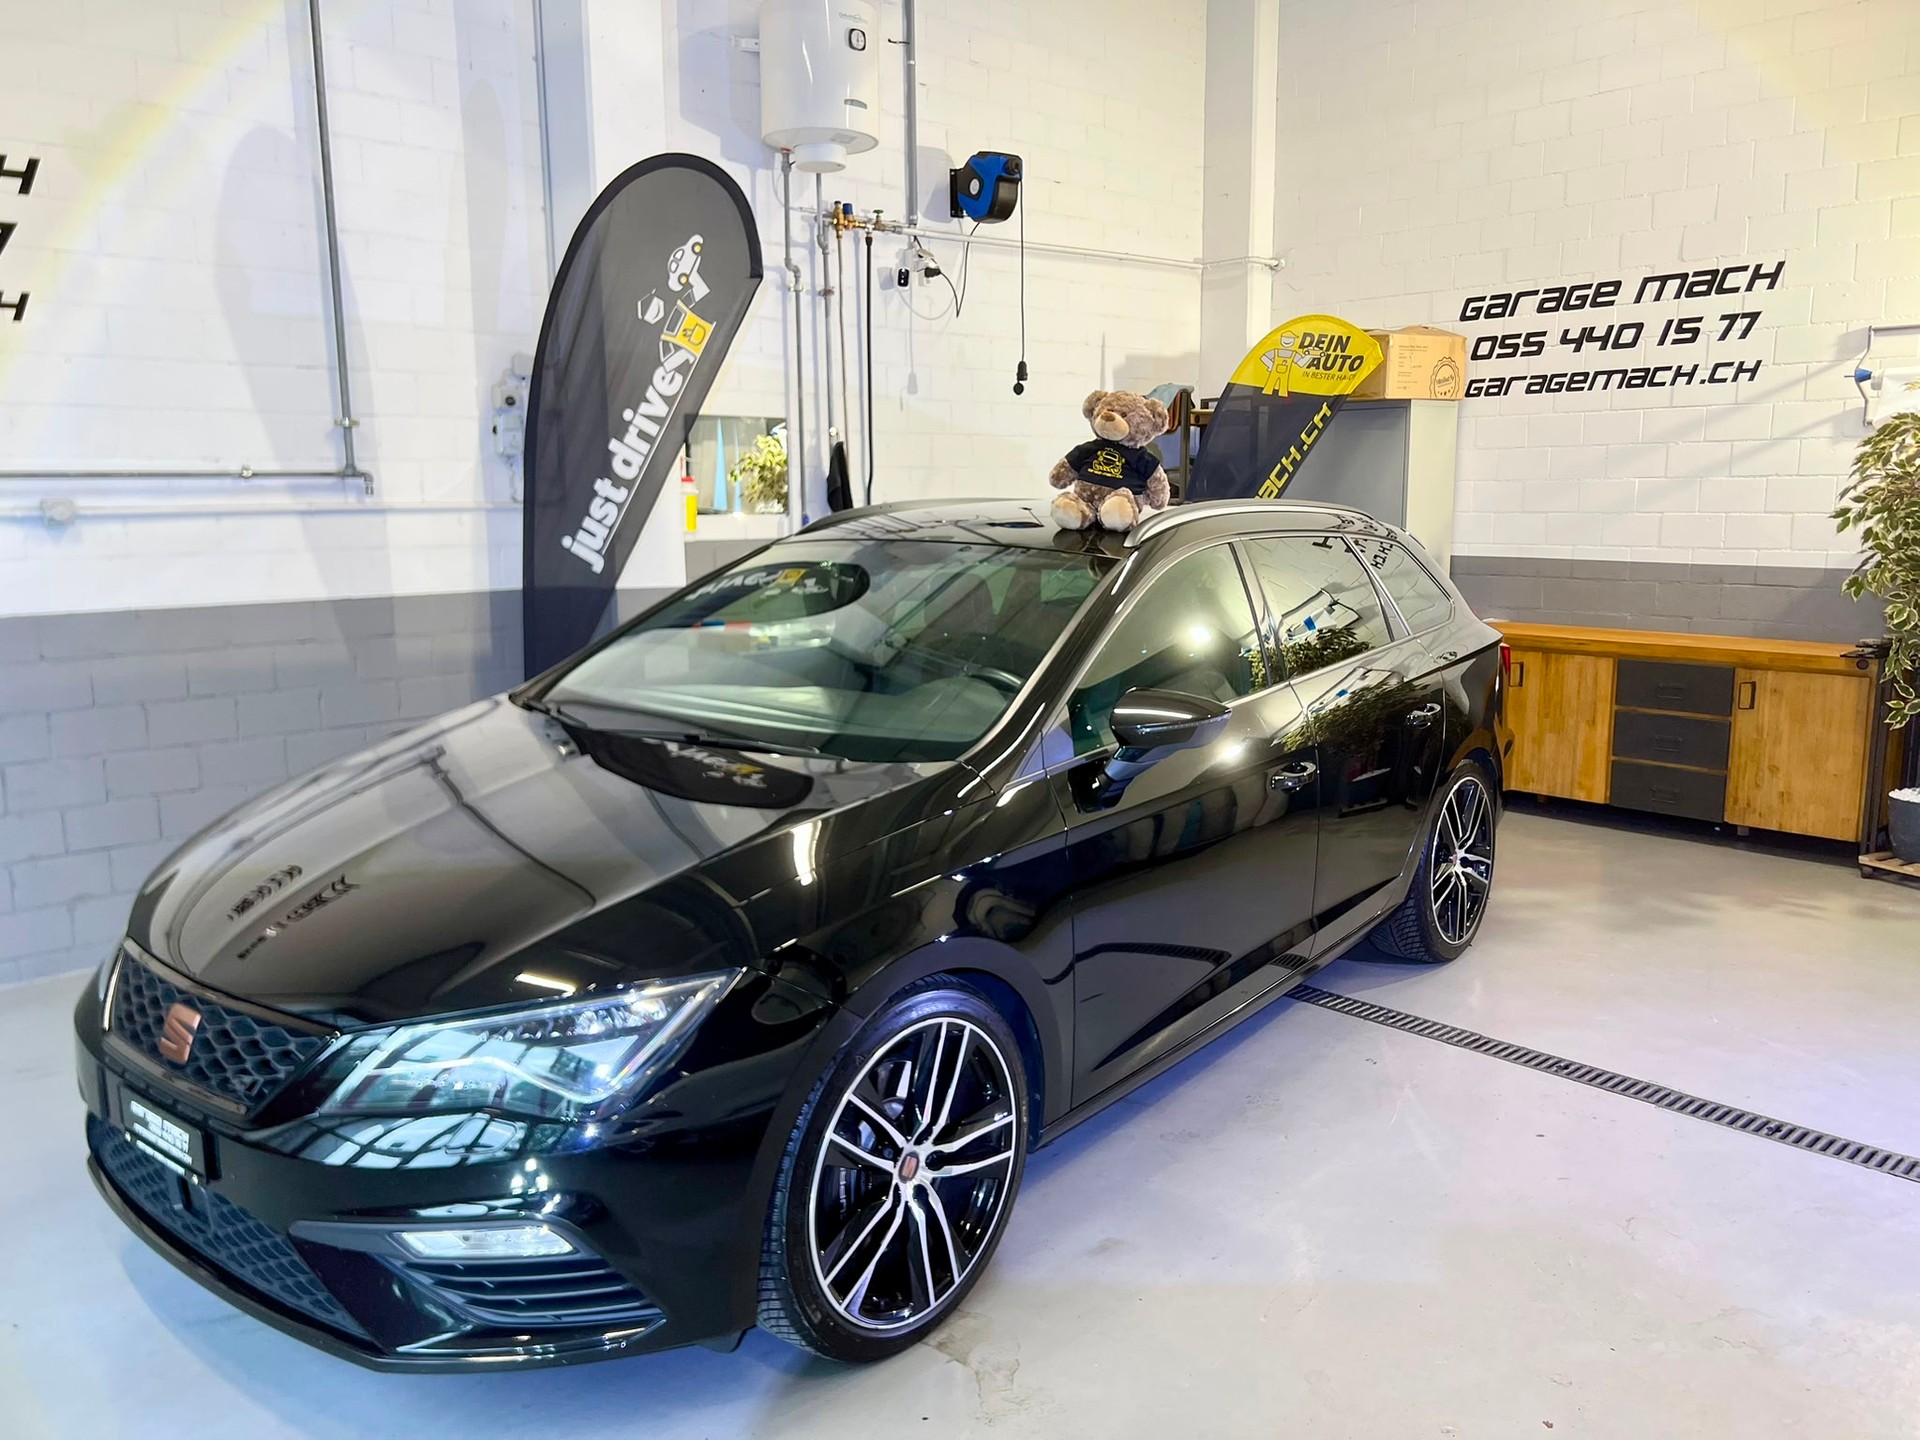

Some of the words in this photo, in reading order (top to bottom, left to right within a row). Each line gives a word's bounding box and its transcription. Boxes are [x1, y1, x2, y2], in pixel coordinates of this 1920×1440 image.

[1299, 332, 1352, 353] DEIN
[1470, 330, 1548, 361] 055
[1560, 321, 1645, 353] 440
[1716, 310, 1763, 342] 77
[1305, 353, 1365, 373] AUTO
[1310, 372, 1336, 381] BESTER
[560, 476, 630, 575] just
